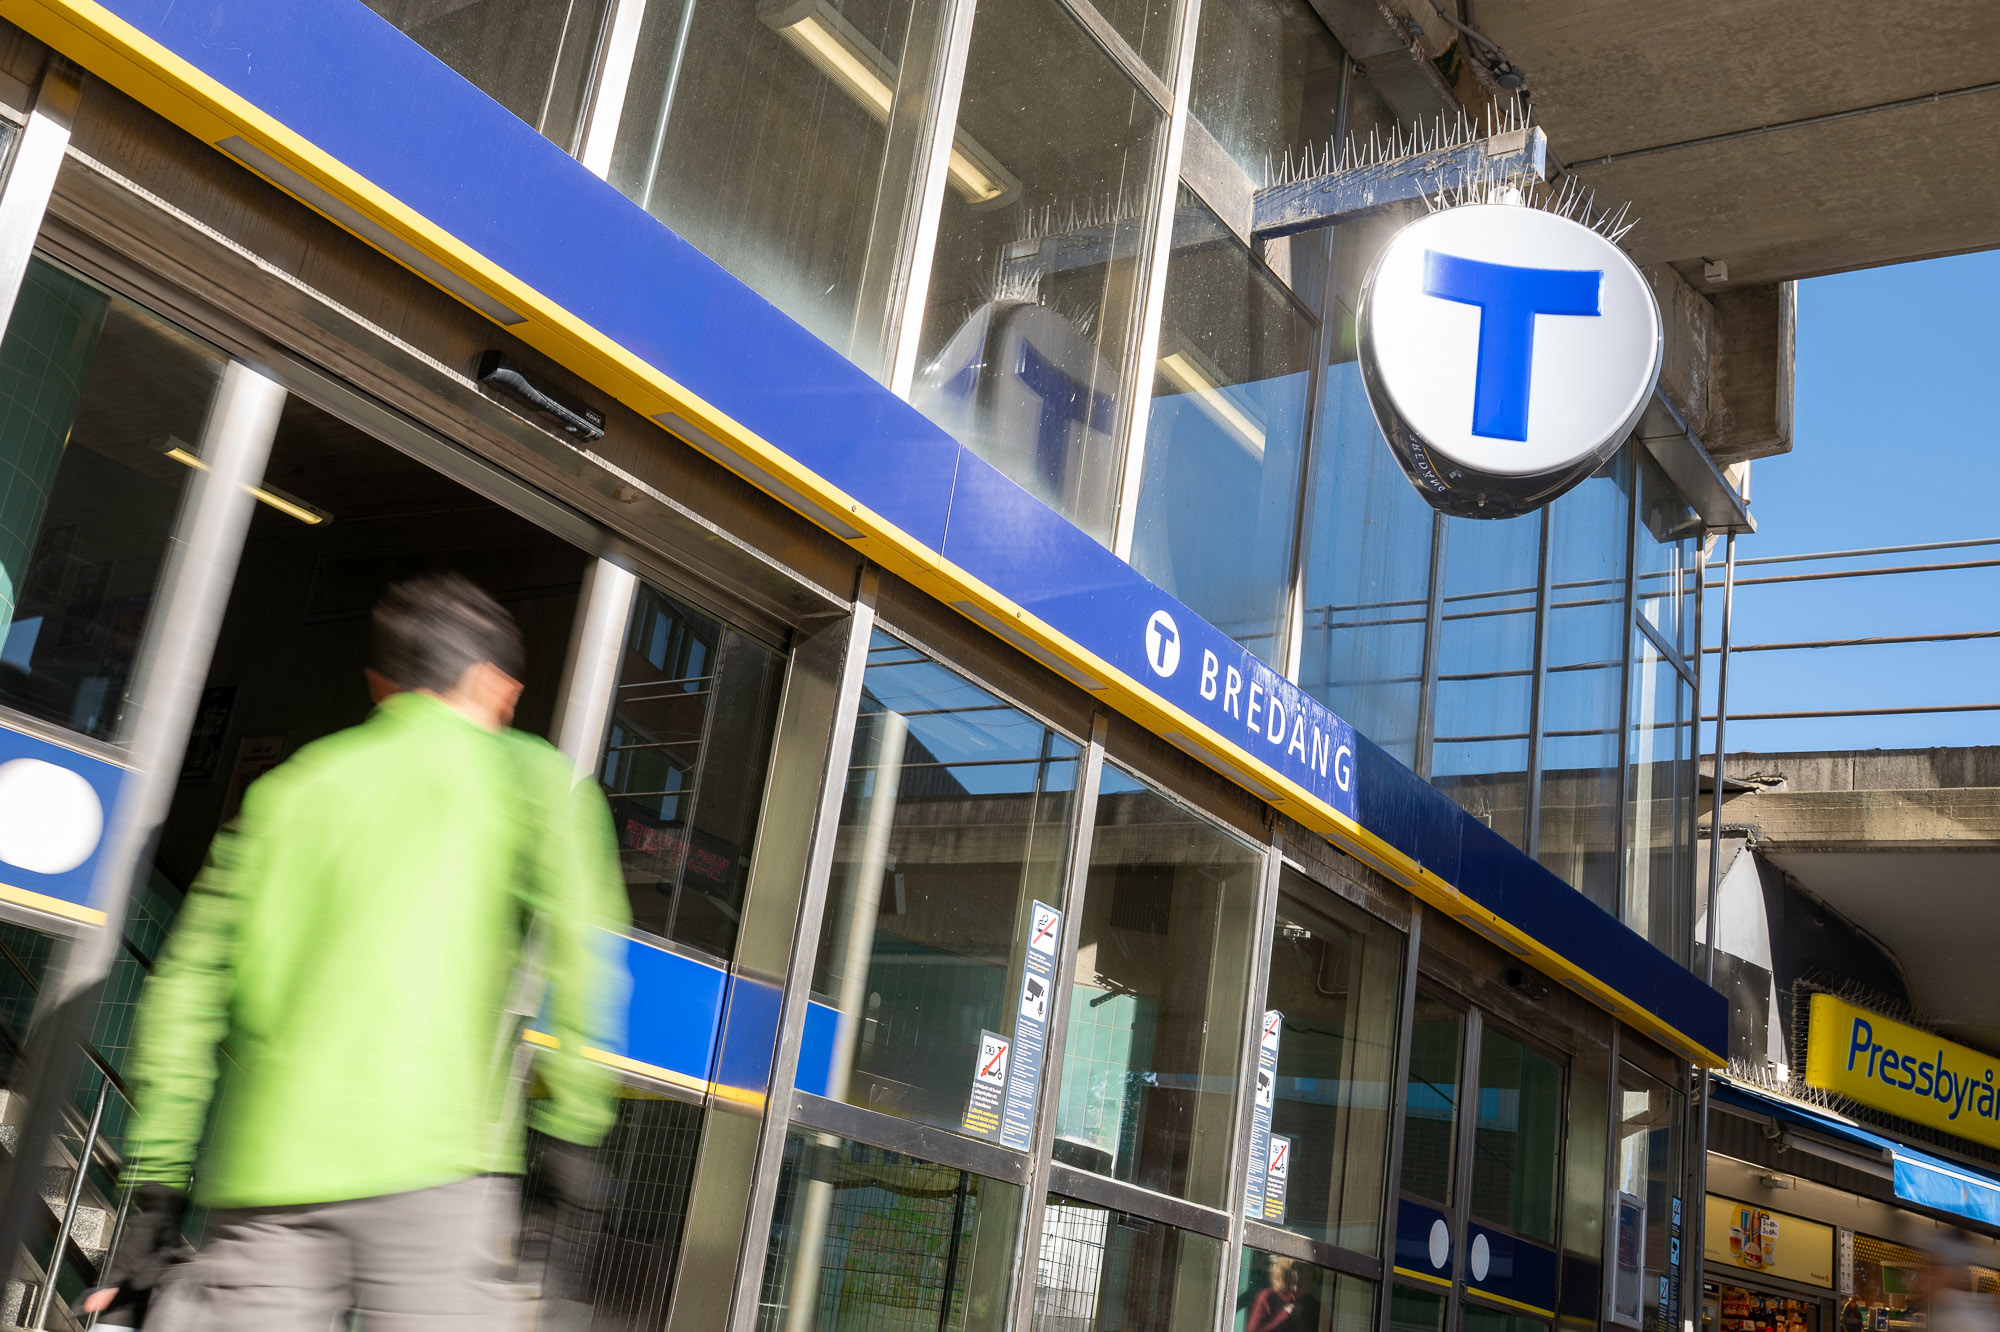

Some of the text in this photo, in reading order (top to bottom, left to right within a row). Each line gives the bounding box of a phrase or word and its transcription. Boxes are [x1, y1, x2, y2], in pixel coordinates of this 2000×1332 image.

[1421, 248, 1605, 442] T
[1200, 648, 1351, 792] BREDÄNG
[1847, 1016, 2000, 1121] Pressbyrå
